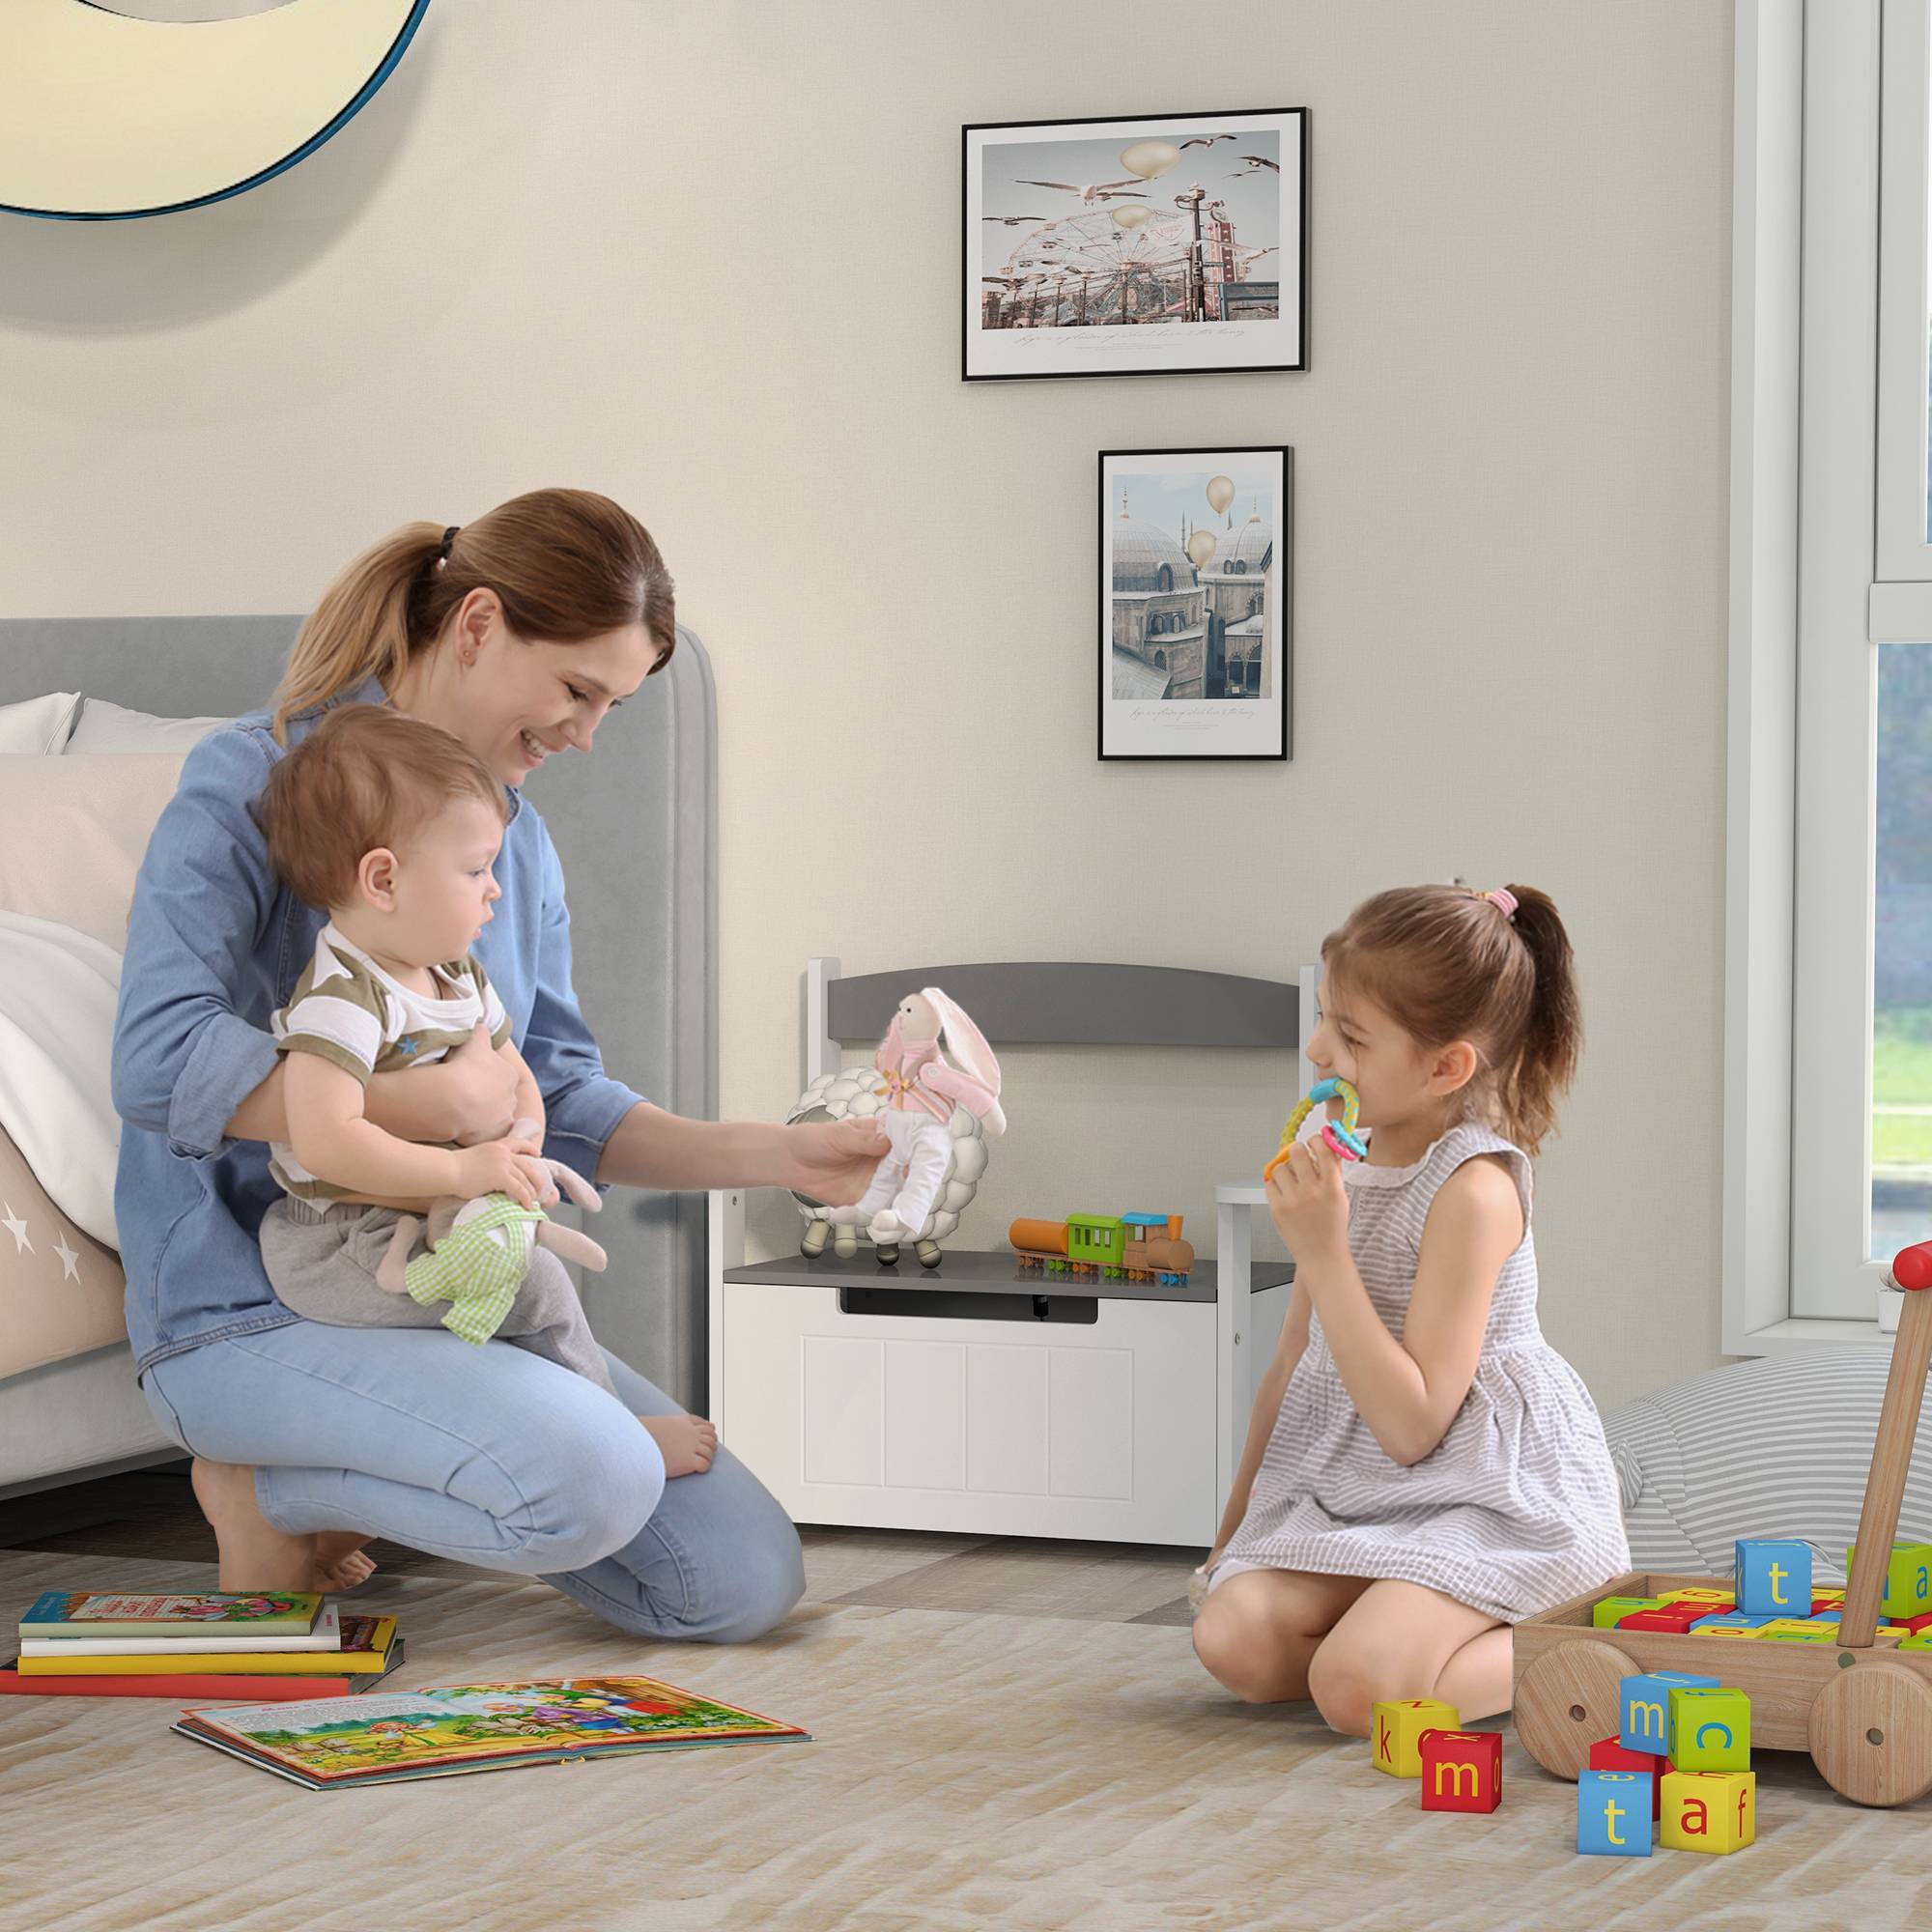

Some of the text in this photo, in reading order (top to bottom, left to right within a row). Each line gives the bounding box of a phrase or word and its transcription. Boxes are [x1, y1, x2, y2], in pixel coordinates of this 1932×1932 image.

[1768, 1562, 1789, 1605] t
[1916, 1565, 1928, 1600] a
[1442, 1733, 1482, 1743] x
[1629, 1699, 1664, 1740] m
[1695, 1721, 1733, 1749] c
[1378, 1715, 1392, 1764] k
[1435, 1761, 1480, 1798] m
[1603, 1799, 1627, 1845] t
[1679, 1798, 1709, 1835] a
[1738, 1787, 1748, 1839] f
